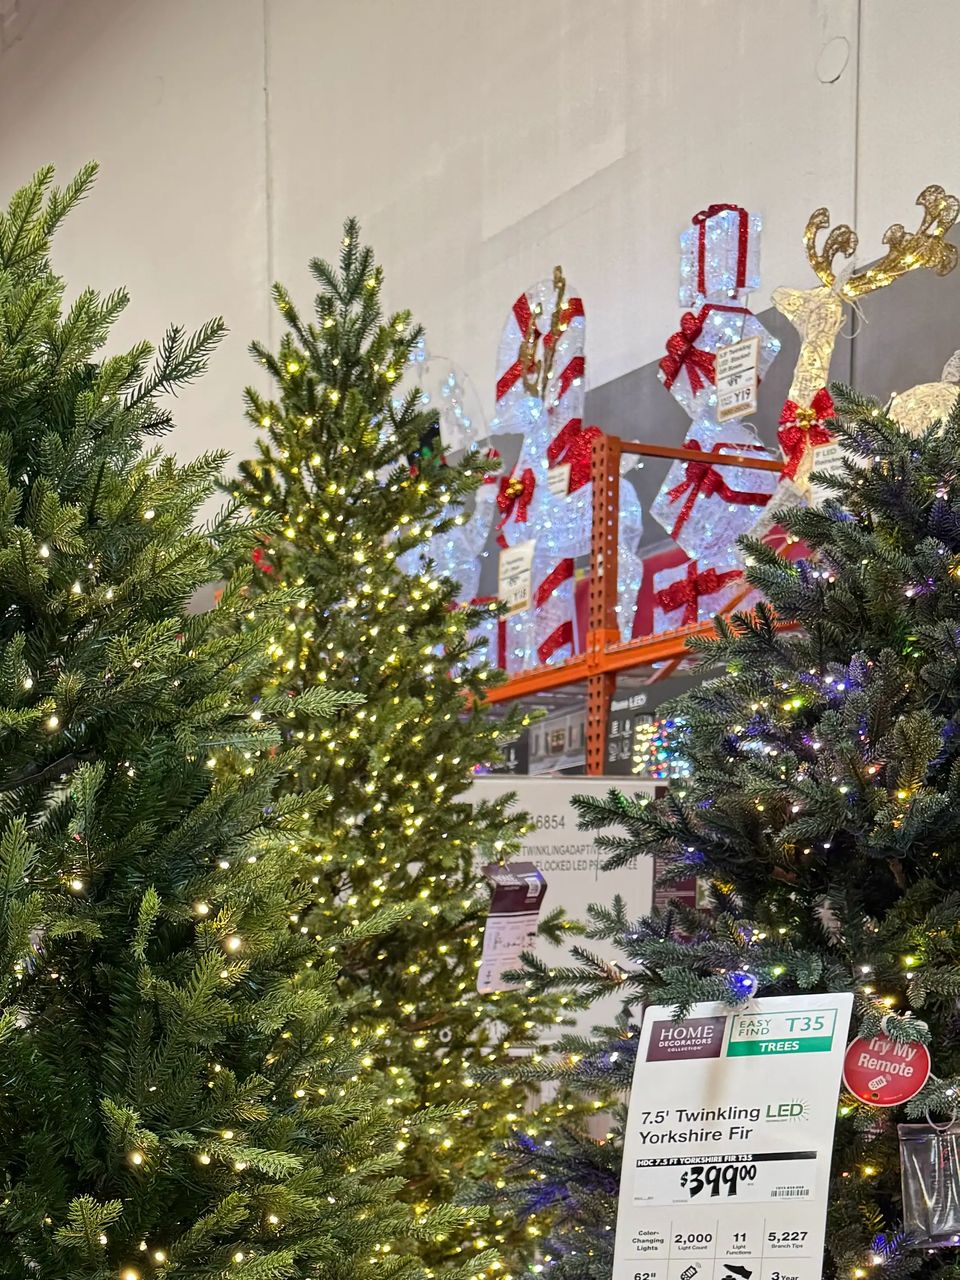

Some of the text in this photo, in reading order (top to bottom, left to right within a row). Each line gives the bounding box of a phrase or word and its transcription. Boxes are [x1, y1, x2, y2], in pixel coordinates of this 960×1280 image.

[740, 1018, 772, 1028] EASY
[784, 1016, 826, 1034] T35
[660, 1025, 715, 1041] HOME
[738, 1027, 770, 1036] FIND
[658, 1038, 712, 1048] DECORATORS
[759, 1040, 800, 1052] TREES
[892, 1039, 916, 1062] My
[858, 1053, 914, 1078] Remote
[641, 1103, 804, 1126] 7.5' Twinkling LED
[638, 1126, 754, 1145] Yorkshire Fir
[654, 1158, 668, 1166] 7.5
[680, 1155, 723, 1165] YORKSHIRE
[724, 1154, 738, 1162] FIR
[738, 1154, 753, 1162] T35
[632, 1237, 664, 1245] Changing
[674, 1233, 713, 1246] 2,000
[733, 1232, 747, 1242] 11
[767, 1231, 808, 1243] 5,227
